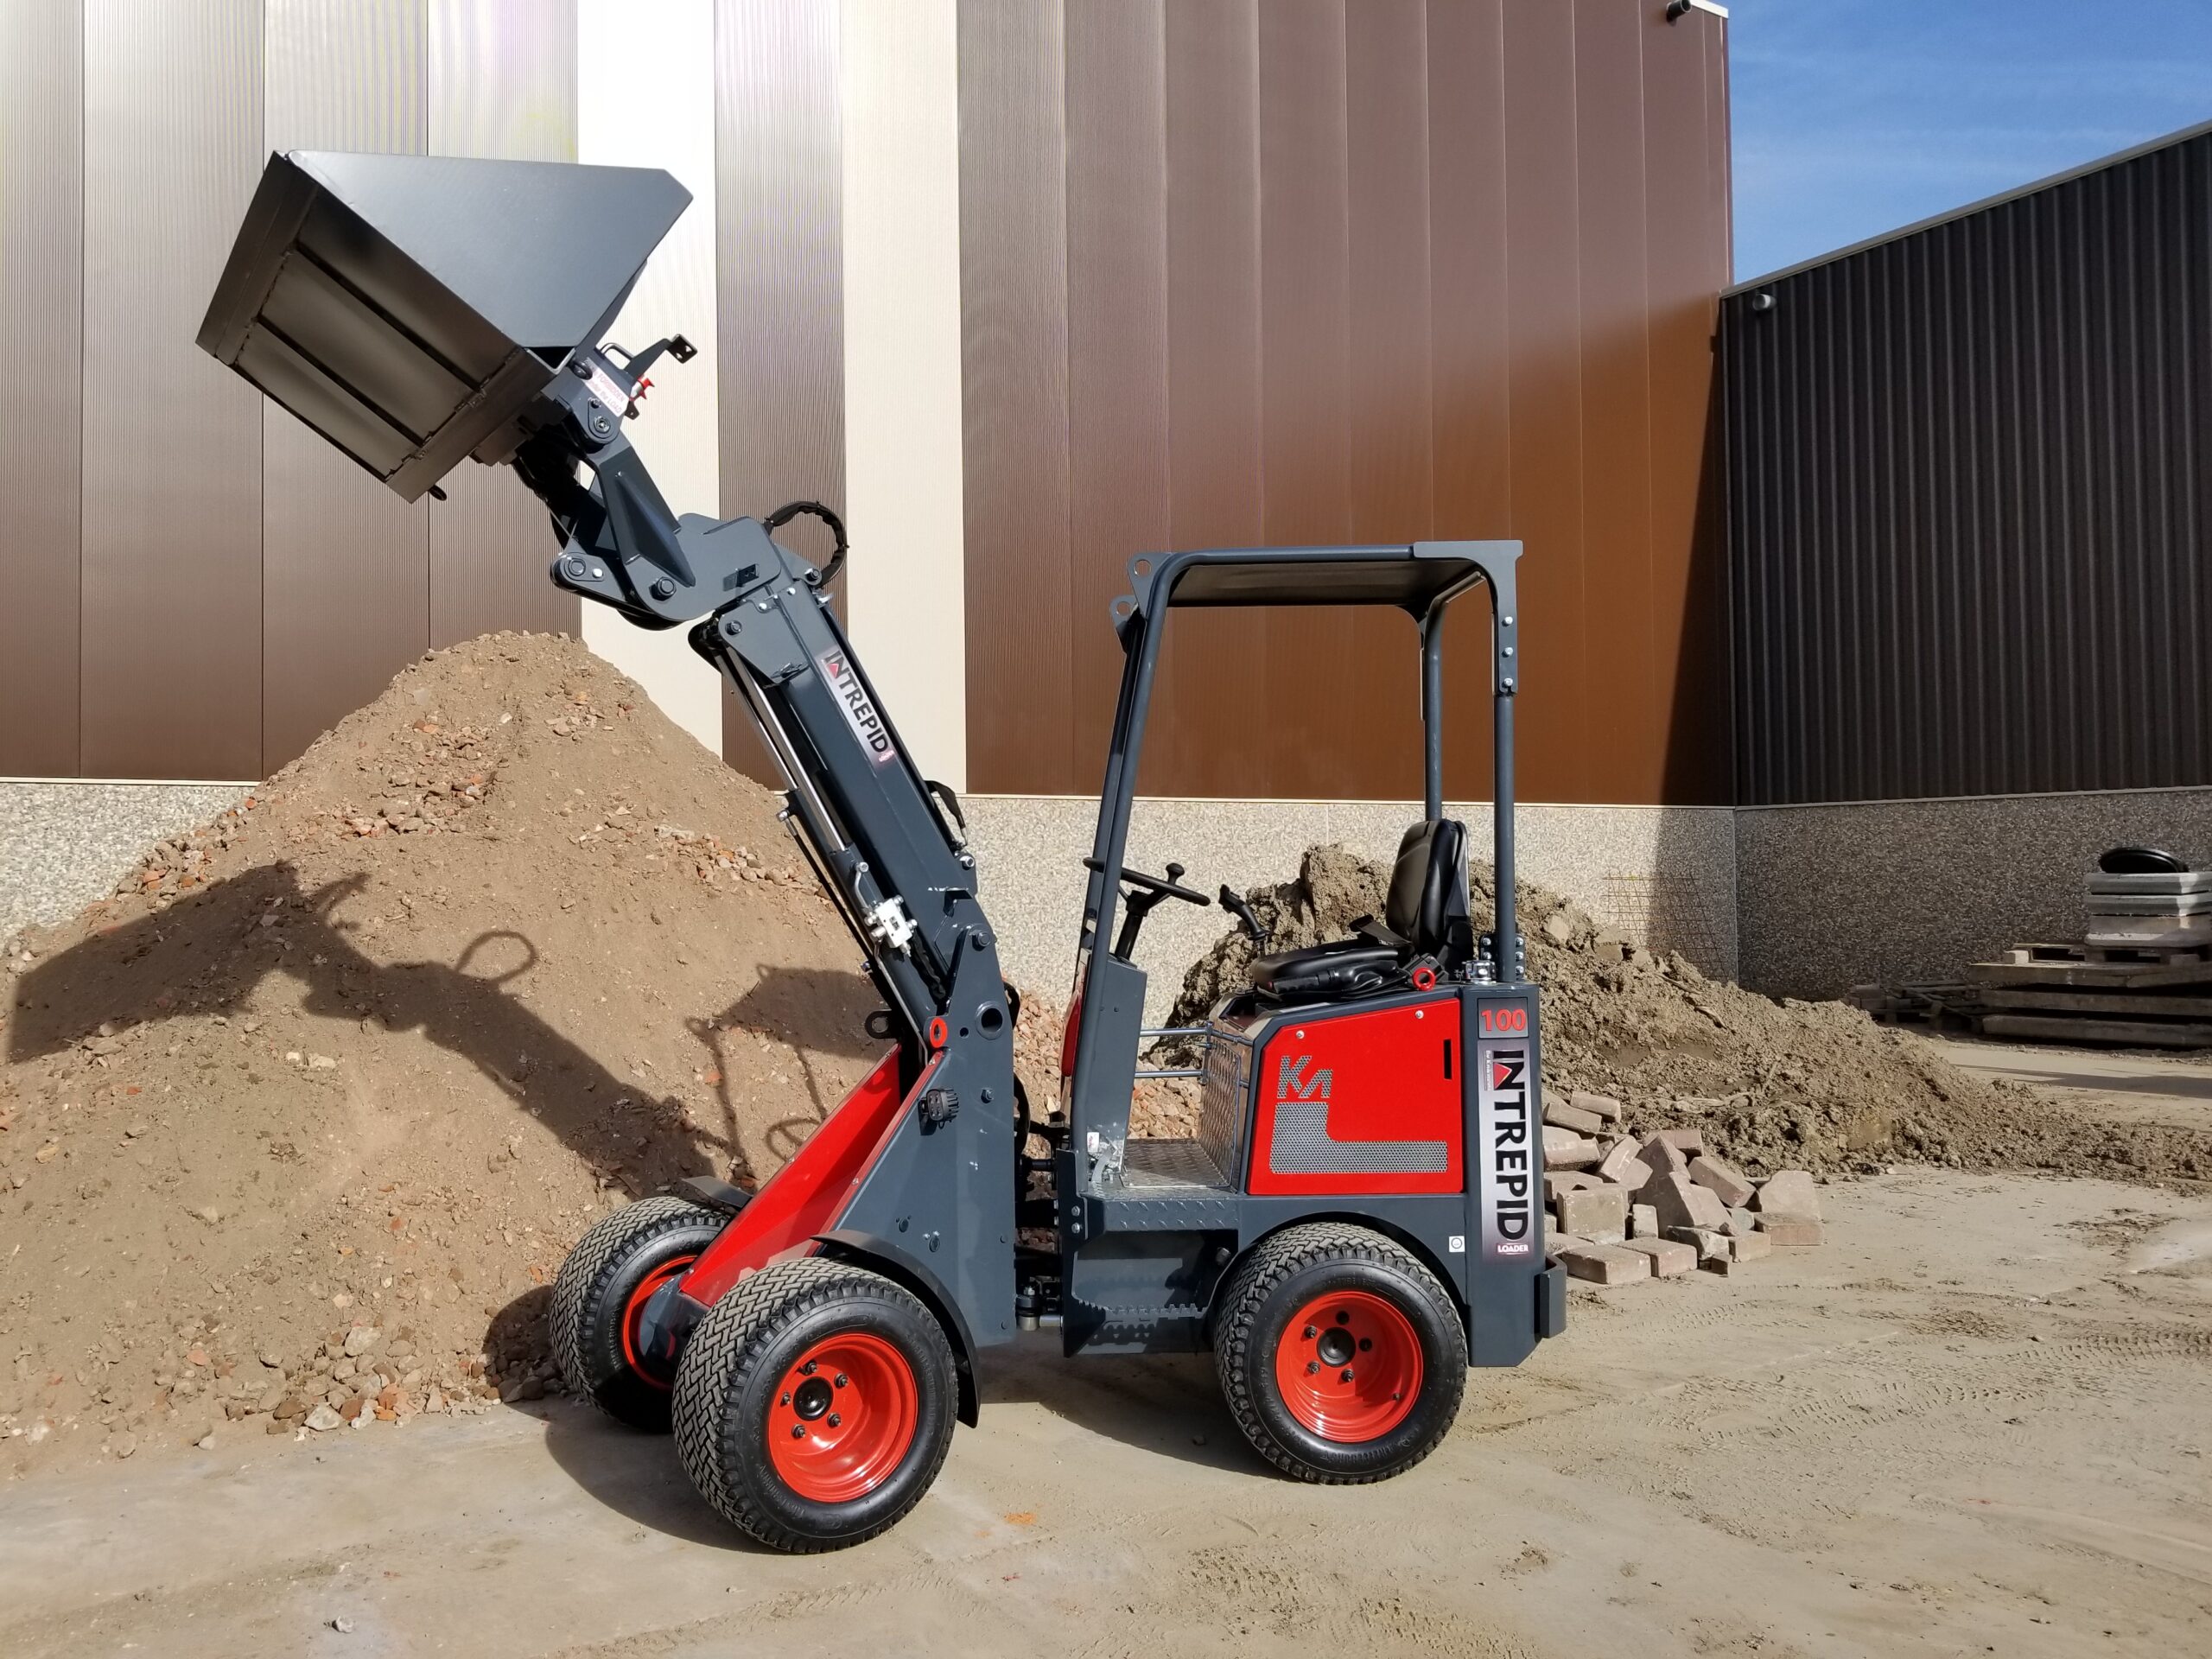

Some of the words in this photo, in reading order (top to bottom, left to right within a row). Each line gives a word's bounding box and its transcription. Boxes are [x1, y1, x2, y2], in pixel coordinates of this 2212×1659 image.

[823, 650, 888, 753] INTREPID
[1481, 1008, 1527, 1032] 100
[1493, 1050, 1529, 1241] INTREPID
[1497, 1244, 1529, 1253] LOADER
